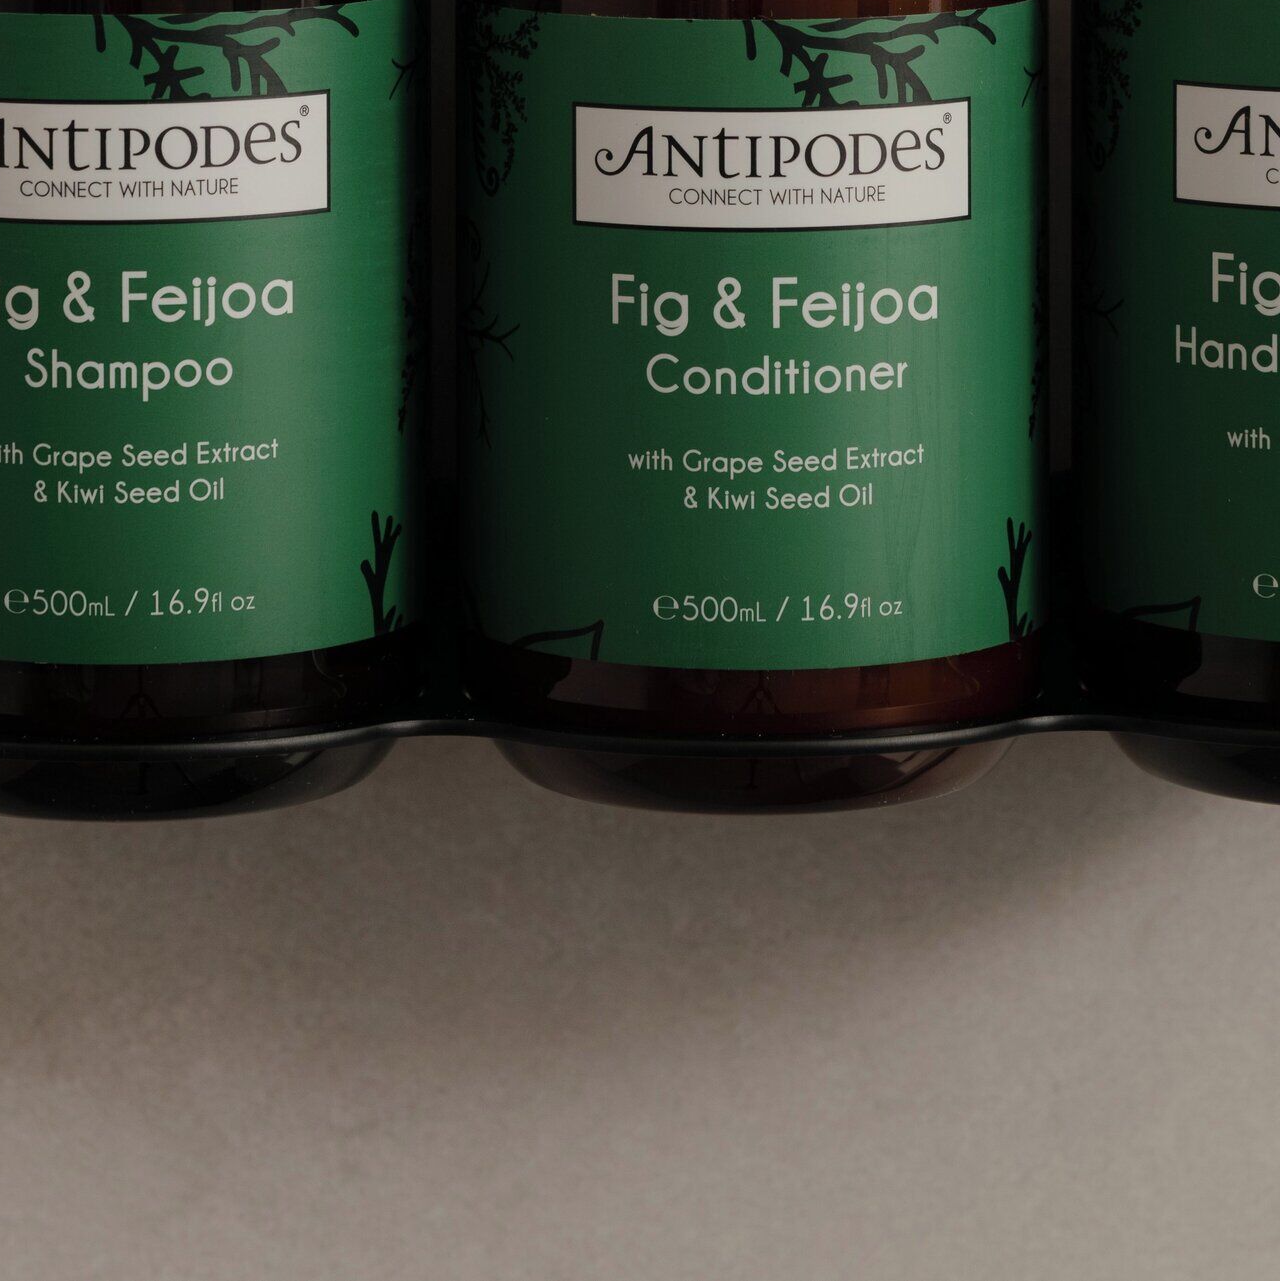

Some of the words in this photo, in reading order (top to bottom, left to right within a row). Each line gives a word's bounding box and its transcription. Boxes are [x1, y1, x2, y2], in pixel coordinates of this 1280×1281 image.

[18, 179, 113, 199] CONNECT
[118, 180, 165, 199] WITH
[170, 177, 239, 197] NATURE
[667, 187, 763, 206] CONNECT
[768, 188, 814, 206] WITH
[820, 184, 886, 205] NATURE
[62, 270, 95, 324] &
[121, 270, 293, 327] Feijoa
[611, 273, 689, 337] Fig
[713, 276, 746, 330] &
[772, 276, 938, 332] Feijoa
[1175, 324, 1278, 373] Hand
[24, 347, 233, 402] Shampoo
[646, 353, 908, 396] Conditioner
[1227, 427, 1271, 450] with
[32, 442, 113, 474] Grape
[121, 442, 187, 467] Seed
[196, 438, 279, 465] Extract
[628, 448, 673, 471] with
[682, 449, 764, 480] Grape
[772, 448, 837, 473] Seed
[846, 443, 925, 470] Extract
[33, 479, 48, 503] &
[57, 480, 104, 504] Kiwi
[114, 479, 180, 504] Seed
[188, 477, 224, 502] Oil
[683, 485, 698, 509] &
[708, 486, 755, 510] Kiwi
[765, 485, 830, 510] Seed
[838, 482, 873, 507] Oil
[230, 595, 256, 612] oz
[878, 600, 903, 617] oz
